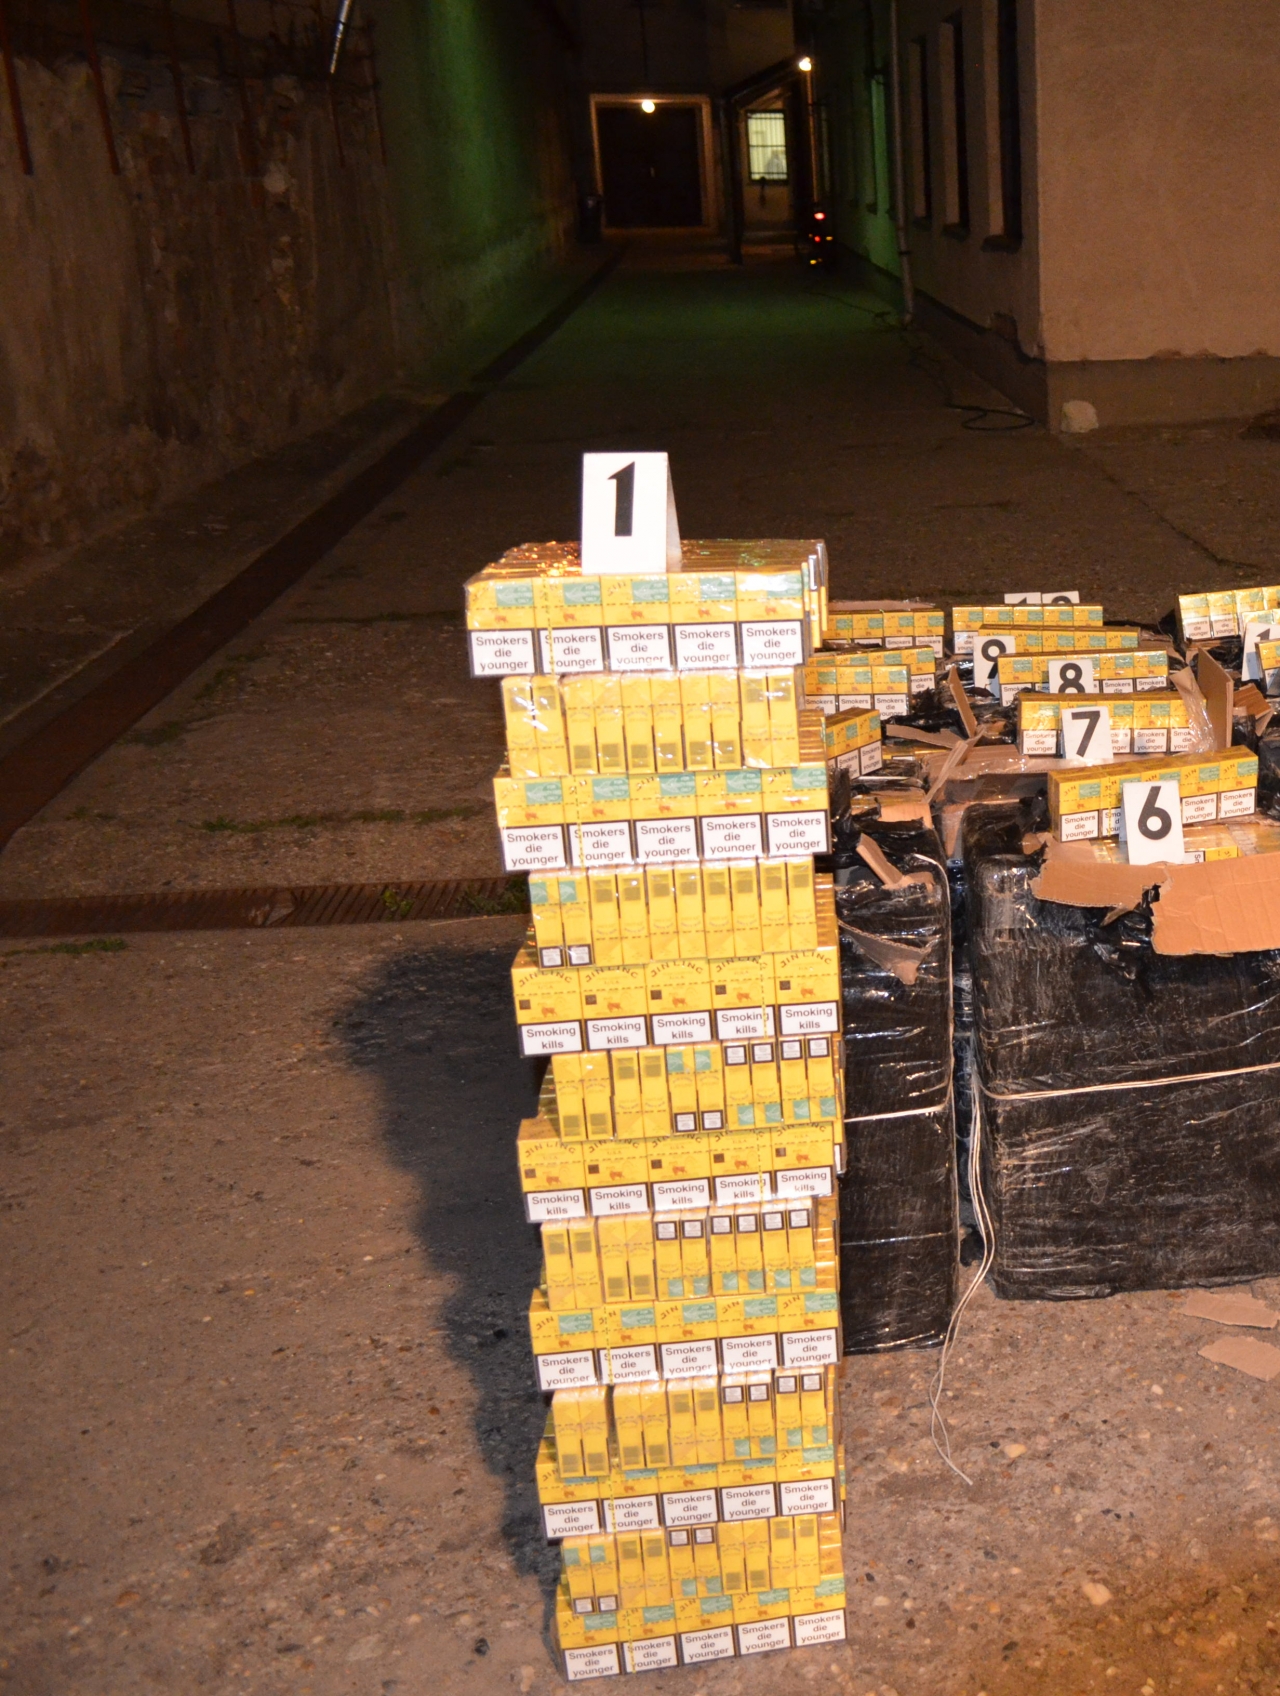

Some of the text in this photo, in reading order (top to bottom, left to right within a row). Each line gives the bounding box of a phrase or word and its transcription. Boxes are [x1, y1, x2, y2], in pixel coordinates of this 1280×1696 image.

[608, 462, 635, 536] 1
[613, 631, 664, 642] Smokers
[680, 630, 730, 639] Smokers
[746, 627, 796, 637] Smokers
[476, 636, 528, 646] Smokers
[545, 634, 596, 644] Smokers
[764, 638, 780, 647] die
[564, 646, 580, 655] die
[630, 642, 648, 653] die
[698, 641, 714, 650] die
[495, 648, 511, 657] die
[750, 651, 796, 661] younger
[981, 639, 1007, 679] 9
[480, 661, 528, 671] younger
[1058, 662, 1086, 693] 8
[1071, 711, 1101, 757] 7
[1223, 791, 1253, 802] Smokers
[1184, 797, 1215, 807] Smokers
[1138, 785, 1172, 840] 6
[1224, 806, 1251, 816] younger
[1064, 814, 1095, 823] Smokers
[1186, 811, 1214, 822] younger
[707, 820, 756, 831] Smokers
[772, 817, 821, 827] Smokers
[575, 828, 625, 838] Smokers
[641, 824, 690, 835] Smokers
[789, 829, 805, 838] die
[1065, 829, 1095, 838] younger
[507, 833, 558, 843] Smokers
[659, 836, 675, 845] die
[724, 832, 740, 841] die
[526, 844, 542, 853] die
[592, 840, 609, 849] die
[710, 844, 755, 854] younger
[776, 840, 820, 851] younger
[645, 848, 690, 859] younger
[511, 856, 558, 867] younger
[722, 1012, 769, 1022] Smoking
[786, 1008, 832, 1018] Smoking
[592, 1022, 641, 1032] Smoking
[658, 1017, 705, 1027] Smoking
[800, 1020, 820, 1029] kills
[527, 1027, 576, 1037] Smoking
[736, 1025, 757, 1034] kills
[607, 1035, 629, 1044] kills
[672, 1031, 693, 1039] kills
[542, 1041, 564, 1049] kills
[781, 1172, 826, 1182] Smoking
[720, 1178, 766, 1188] Smoking
[658, 1184, 704, 1194] Smoking
[734, 1190, 754, 1198] kills
[532, 1193, 580, 1204] Smoking
[595, 1189, 642, 1200] Smoking
[672, 1196, 693, 1204] kills
[610, 1201, 631, 1210] kills
[547, 1207, 568, 1215] kills
[787, 1334, 832, 1344] Smokers
[727, 1339, 772, 1350] Smokers
[604, 1350, 651, 1360] Smokers
[666, 1345, 711, 1355] Smokers
[743, 1350, 757, 1358] die
[542, 1356, 589, 1366] Smokers
[790, 1353, 831, 1364] younger
[559, 1366, 574, 1374] die
[621, 1361, 636, 1369] die
[669, 1364, 711, 1374] younger
[546, 1376, 589, 1386] younger
[784, 1482, 828, 1493] Smokers
[726, 1488, 770, 1499] Smokers
[667, 1494, 712, 1504] Smokers
[742, 1499, 756, 1507] die
[608, 1500, 653, 1510] Smokers
[683, 1504, 698, 1512] die
[788, 1502, 827, 1512] younger
[548, 1505, 593, 1516] Smokers
[729, 1507, 770, 1517] younger
[671, 1512, 712, 1522] younger
[552, 1524, 594, 1534] younger
[799, 1614, 840, 1626] Smokers
[742, 1622, 785, 1634] Smokers
[813, 1624, 827, 1632] die
[686, 1631, 728, 1643] Smokers
[758, 1632, 771, 1640] die
[801, 1630, 840, 1643] younger
[628, 1640, 671, 1650] Smokers
[701, 1641, 715, 1649] die
[746, 1638, 785, 1651] younger
[569, 1648, 613, 1660] Smokers
[643, 1651, 657, 1659] die
[689, 1648, 728, 1660] younger
[585, 1659, 599, 1667] die
[573, 1666, 614, 1677] younger
